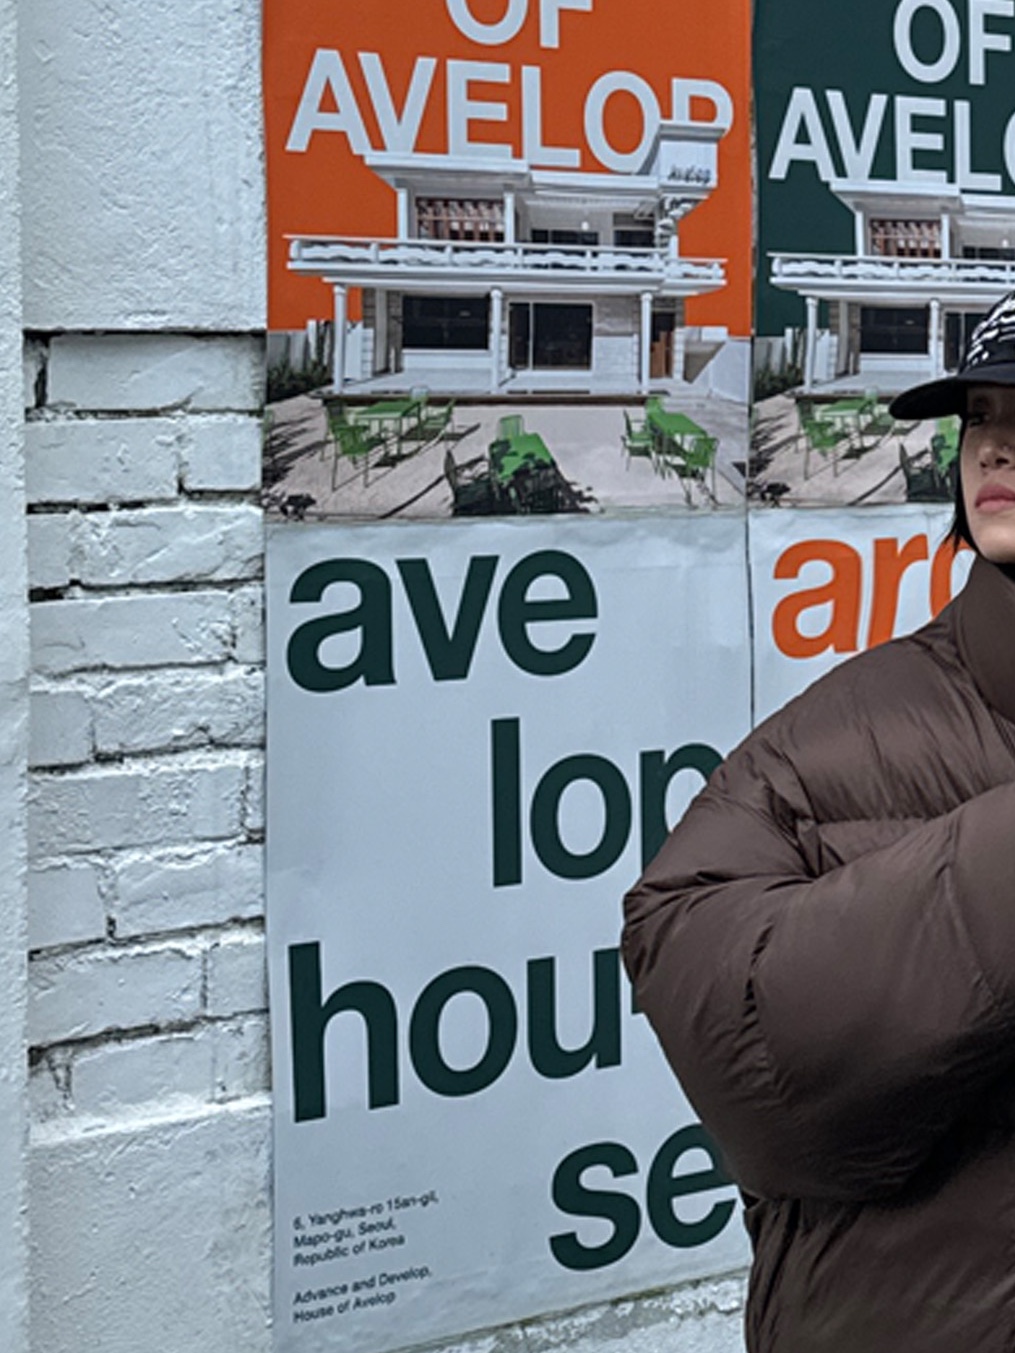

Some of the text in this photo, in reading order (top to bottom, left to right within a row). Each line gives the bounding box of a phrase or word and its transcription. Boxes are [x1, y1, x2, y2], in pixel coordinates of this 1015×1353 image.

[893, 0, 1015, 86] OF
[285, 48, 734, 173] AVELOP
[286, 549, 599, 694] ave
[548, 1122, 739, 1272] se
[293, 1234, 405, 1267] Republic of Korea
[293, 1284, 348, 1305] Advance
[352, 1275, 376, 1292] and
[293, 1292, 396, 1324] House of Avelop
